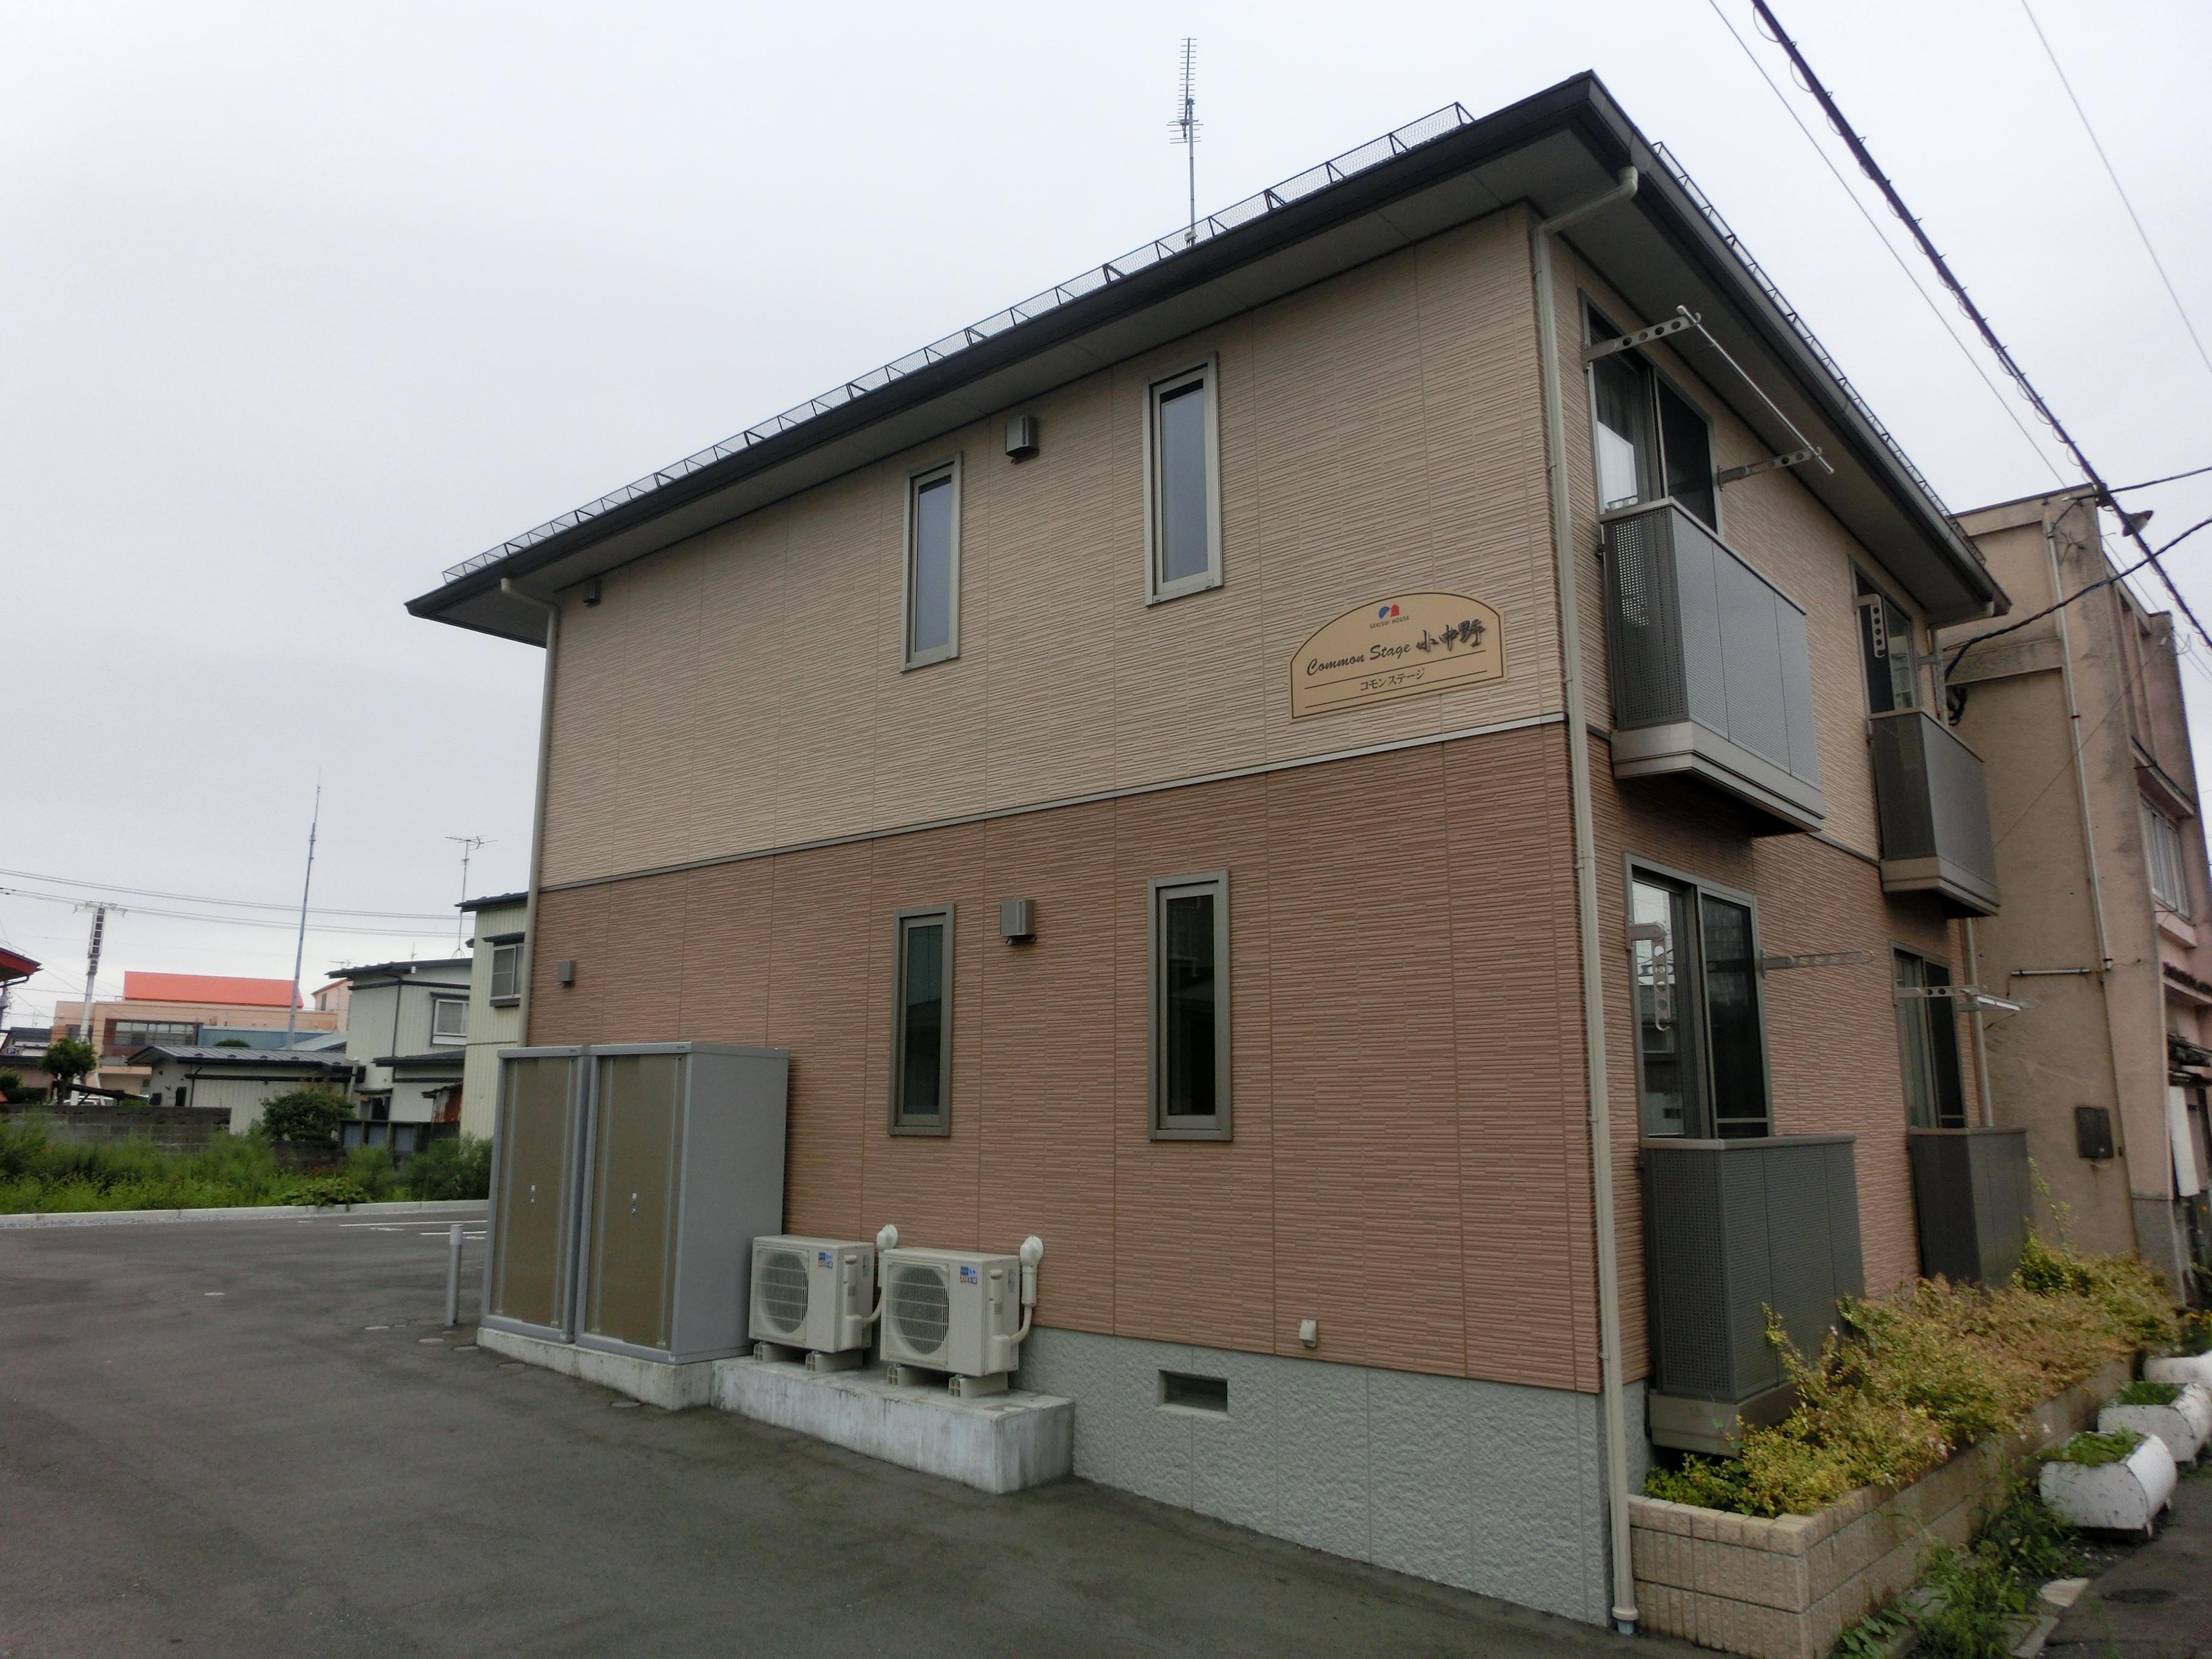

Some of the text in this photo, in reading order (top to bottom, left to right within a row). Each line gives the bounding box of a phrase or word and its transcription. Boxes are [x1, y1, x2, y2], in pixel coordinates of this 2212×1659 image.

[1369, 615, 1410, 629] SEKISUI HOUSE
[1307, 618, 1486, 676] Common Stage 小中野
[1360, 668, 1425, 691] コモンステージ
